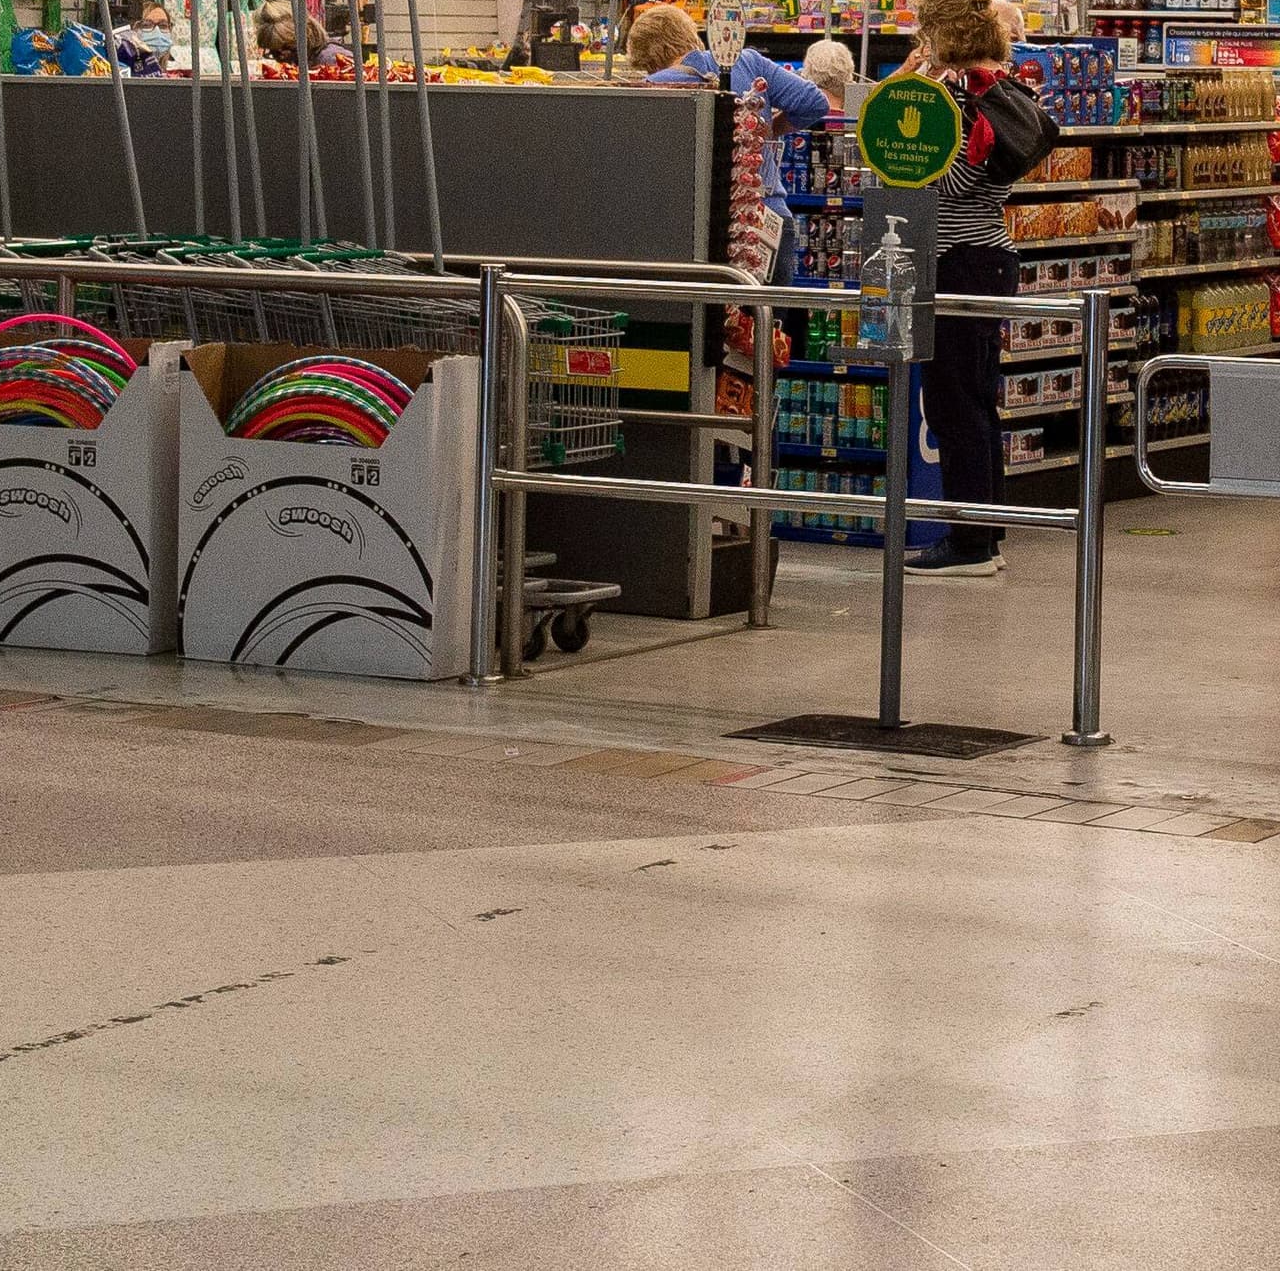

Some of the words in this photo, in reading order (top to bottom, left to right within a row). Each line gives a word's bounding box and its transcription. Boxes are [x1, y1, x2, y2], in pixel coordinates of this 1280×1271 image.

[888, 89, 937, 104] ARRÊTEZ
[891, 140, 905, 149] on
[906, 142, 918, 151] se
[919, 142, 940, 153] lave
[883, 149, 898, 160] les
[899, 151, 930, 163] mains
[193, 463, 245, 504] swoosh
[278, 506, 354, 544] swoosh
